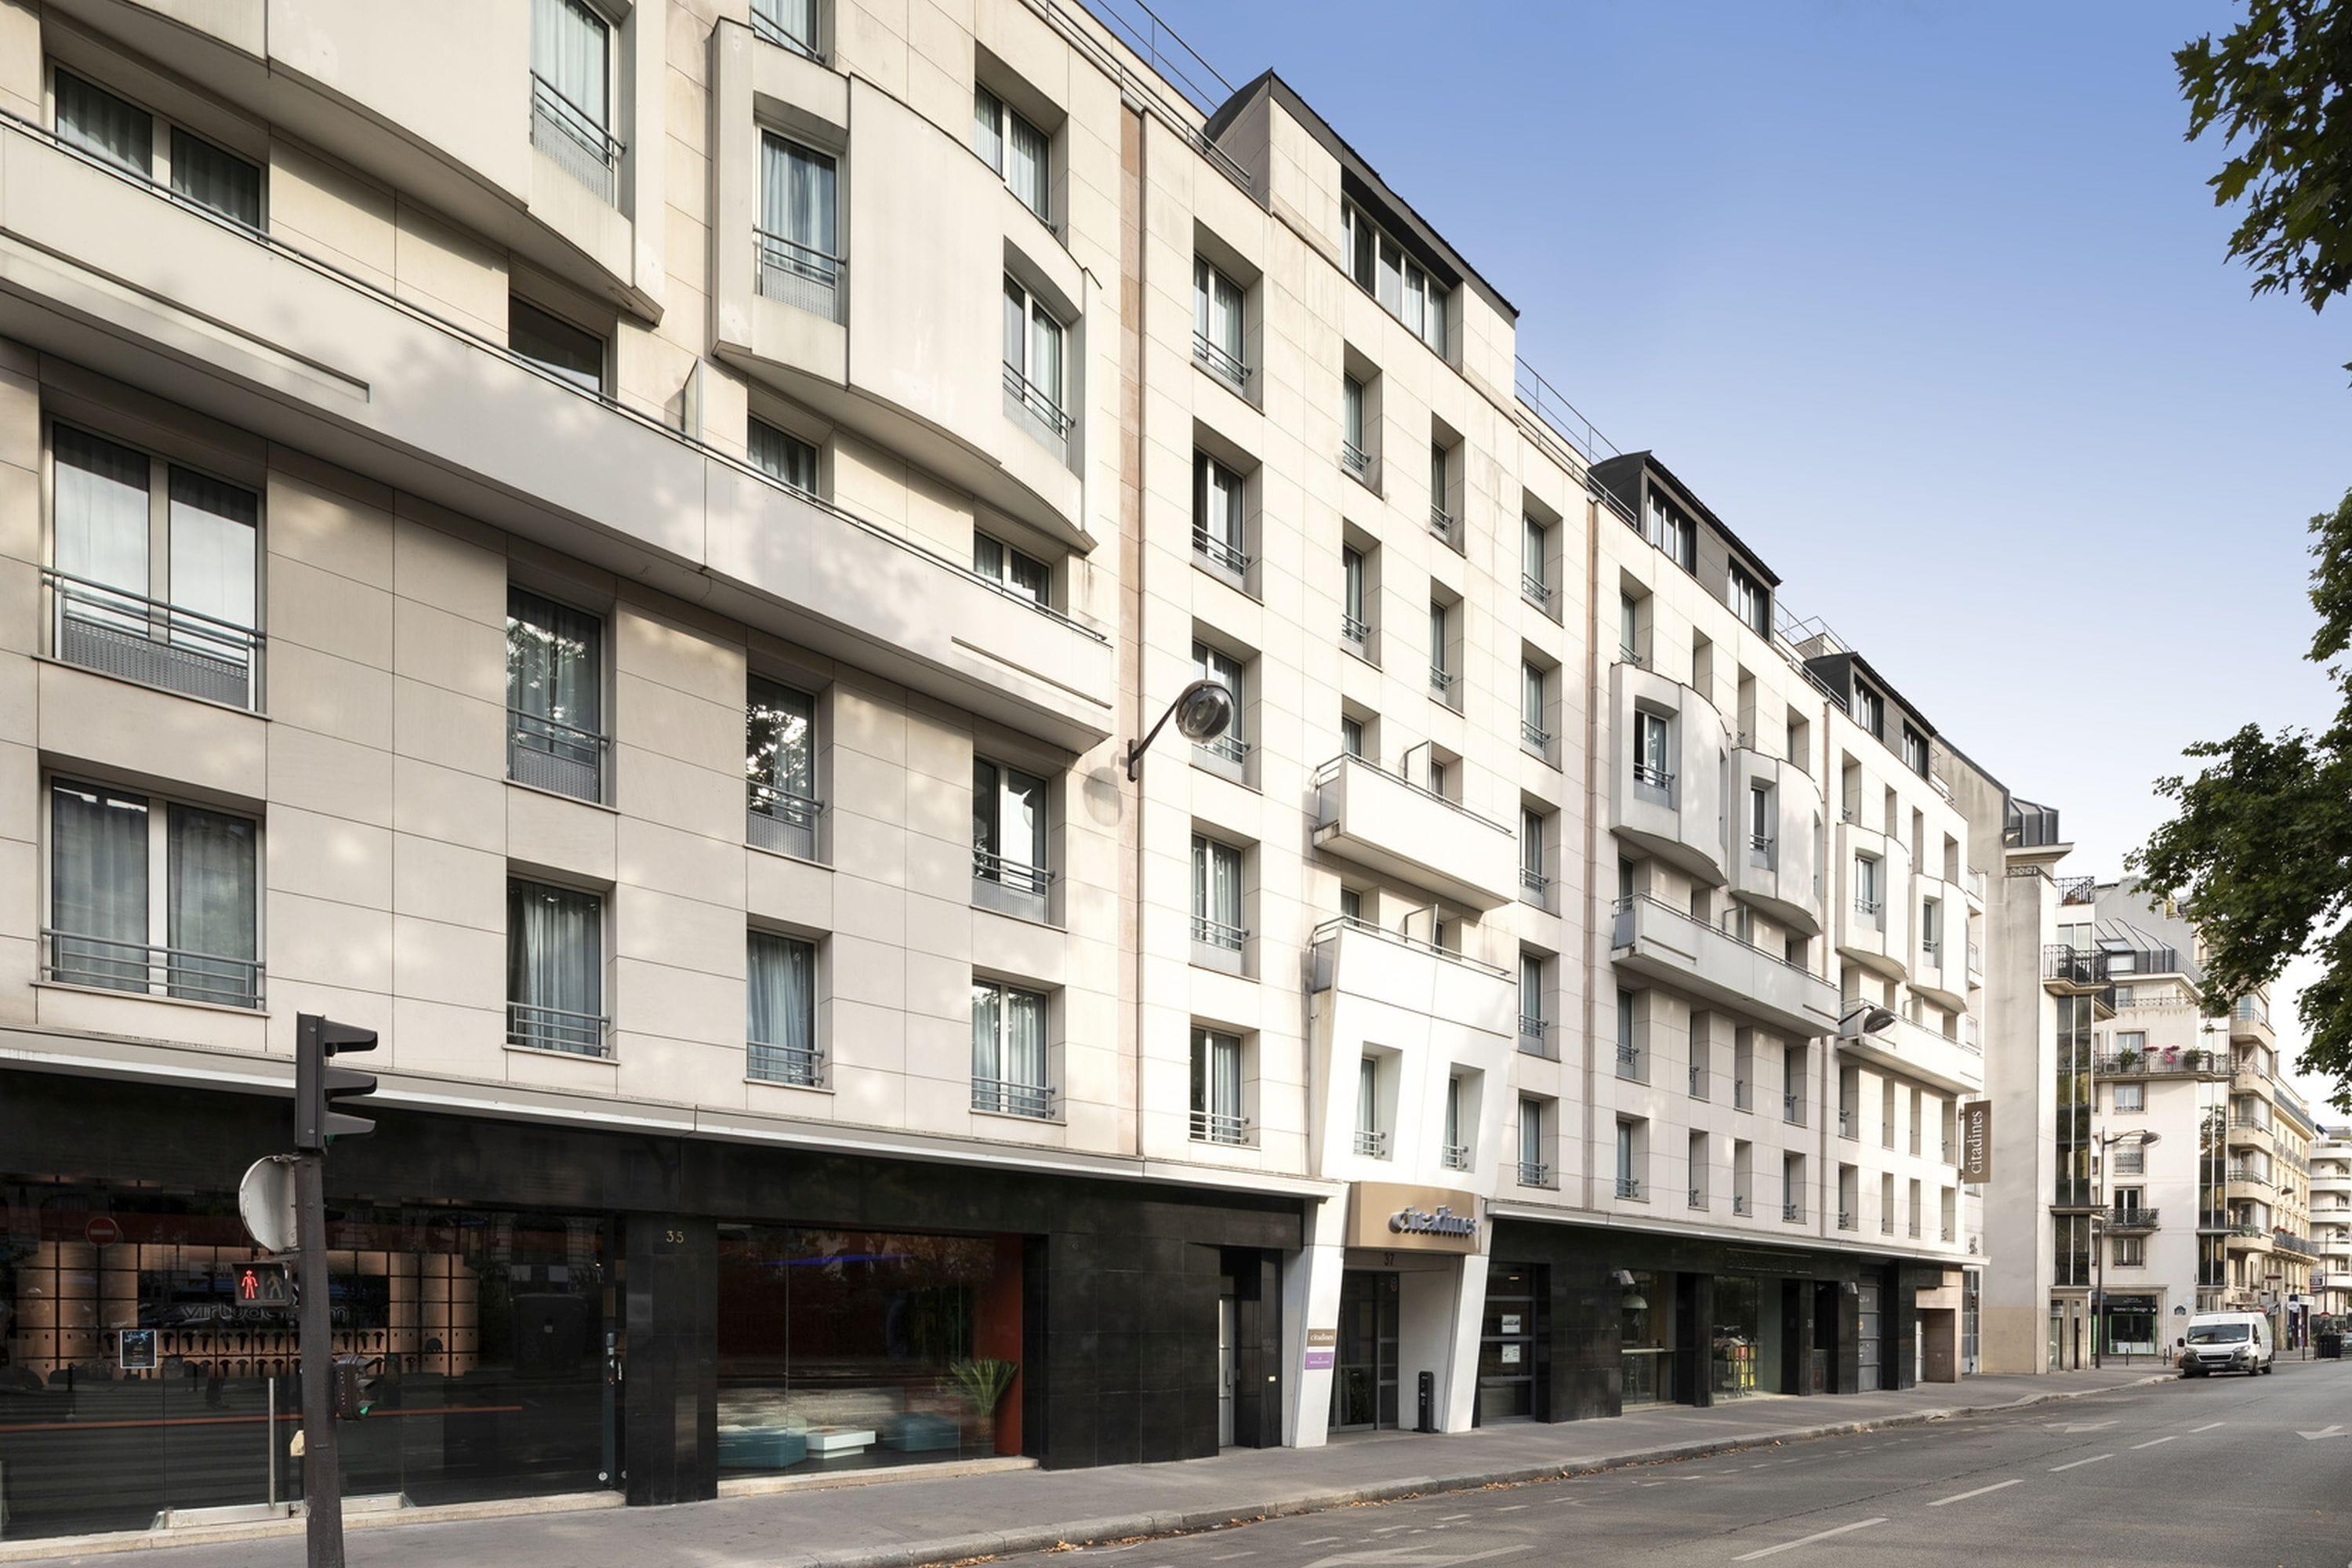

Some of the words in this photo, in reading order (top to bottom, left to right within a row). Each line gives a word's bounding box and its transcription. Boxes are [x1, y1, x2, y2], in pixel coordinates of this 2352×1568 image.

[1966, 1110, 1983, 1174] citadines
[666, 1230, 684, 1243] 35
[1383, 1252, 1395, 1267] 37
